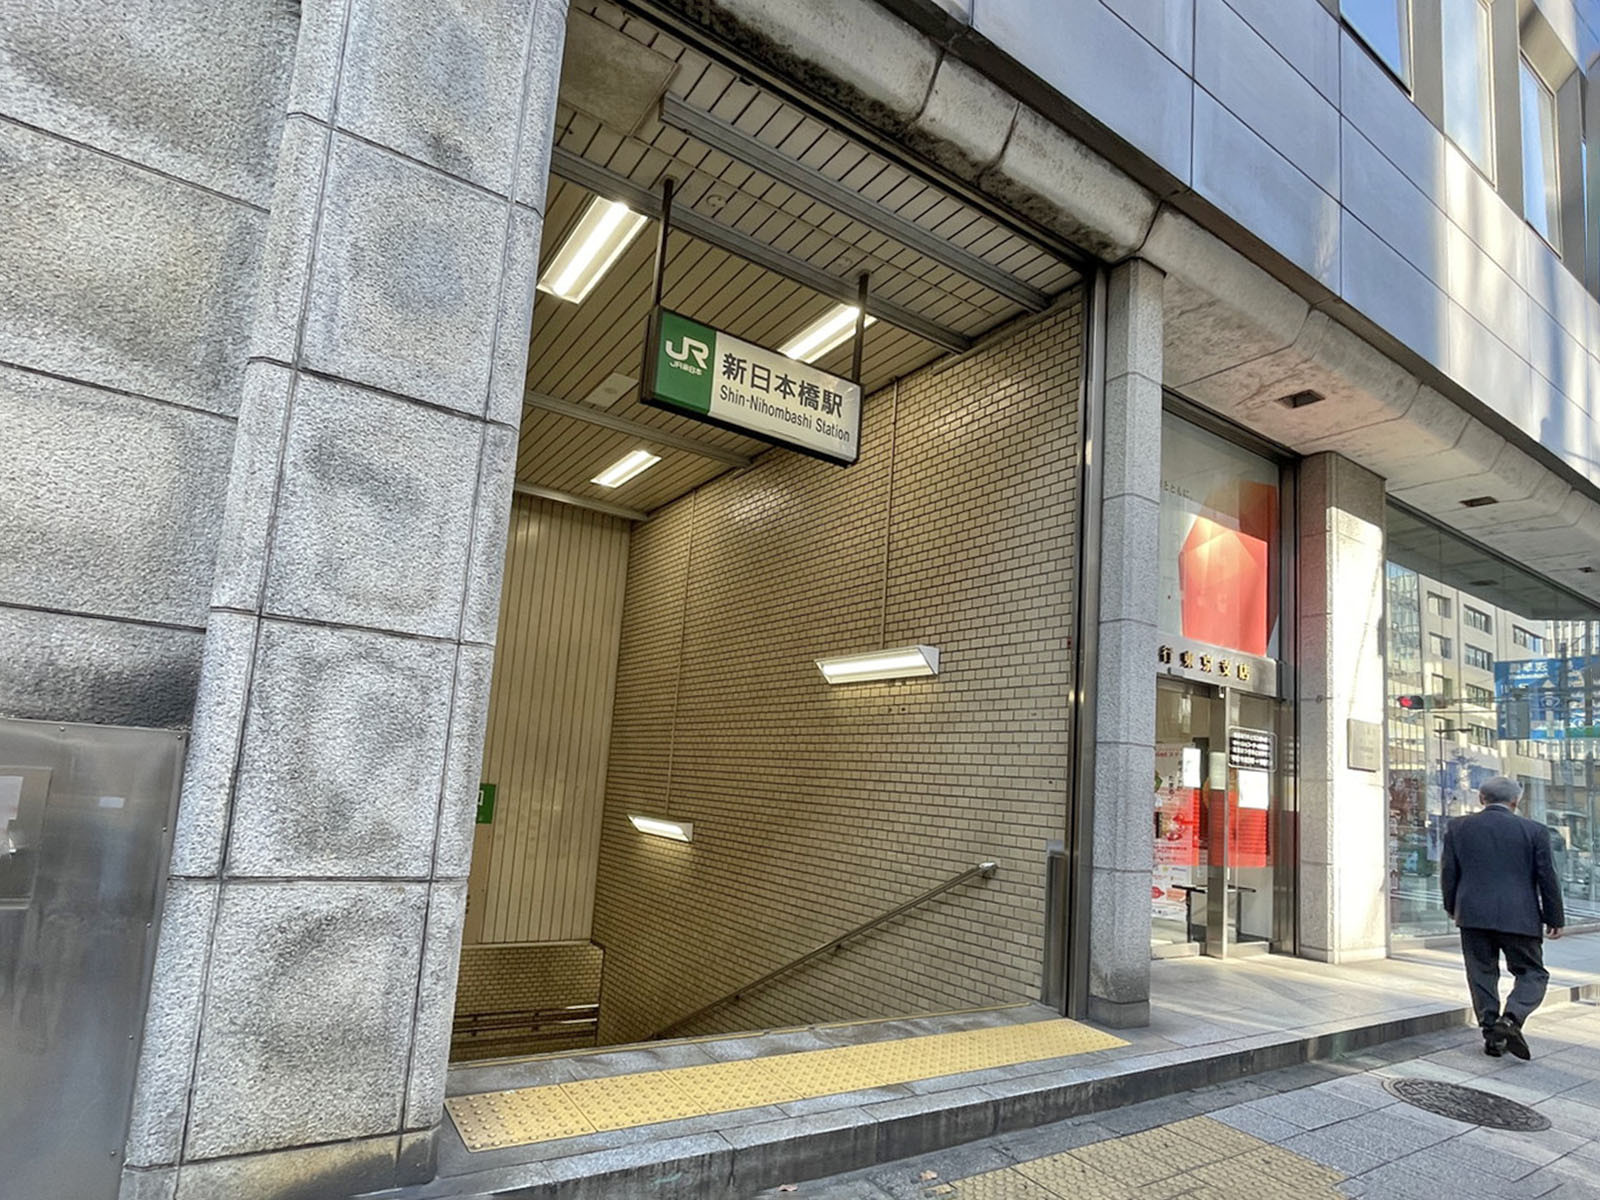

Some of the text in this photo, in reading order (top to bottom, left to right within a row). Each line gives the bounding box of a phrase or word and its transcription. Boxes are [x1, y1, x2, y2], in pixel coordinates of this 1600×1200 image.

[665, 336, 709, 370] JR
[720, 384, 851, 443] Shin-Nihombashi Station
[722, 352, 843, 419] 新日本橋駅
